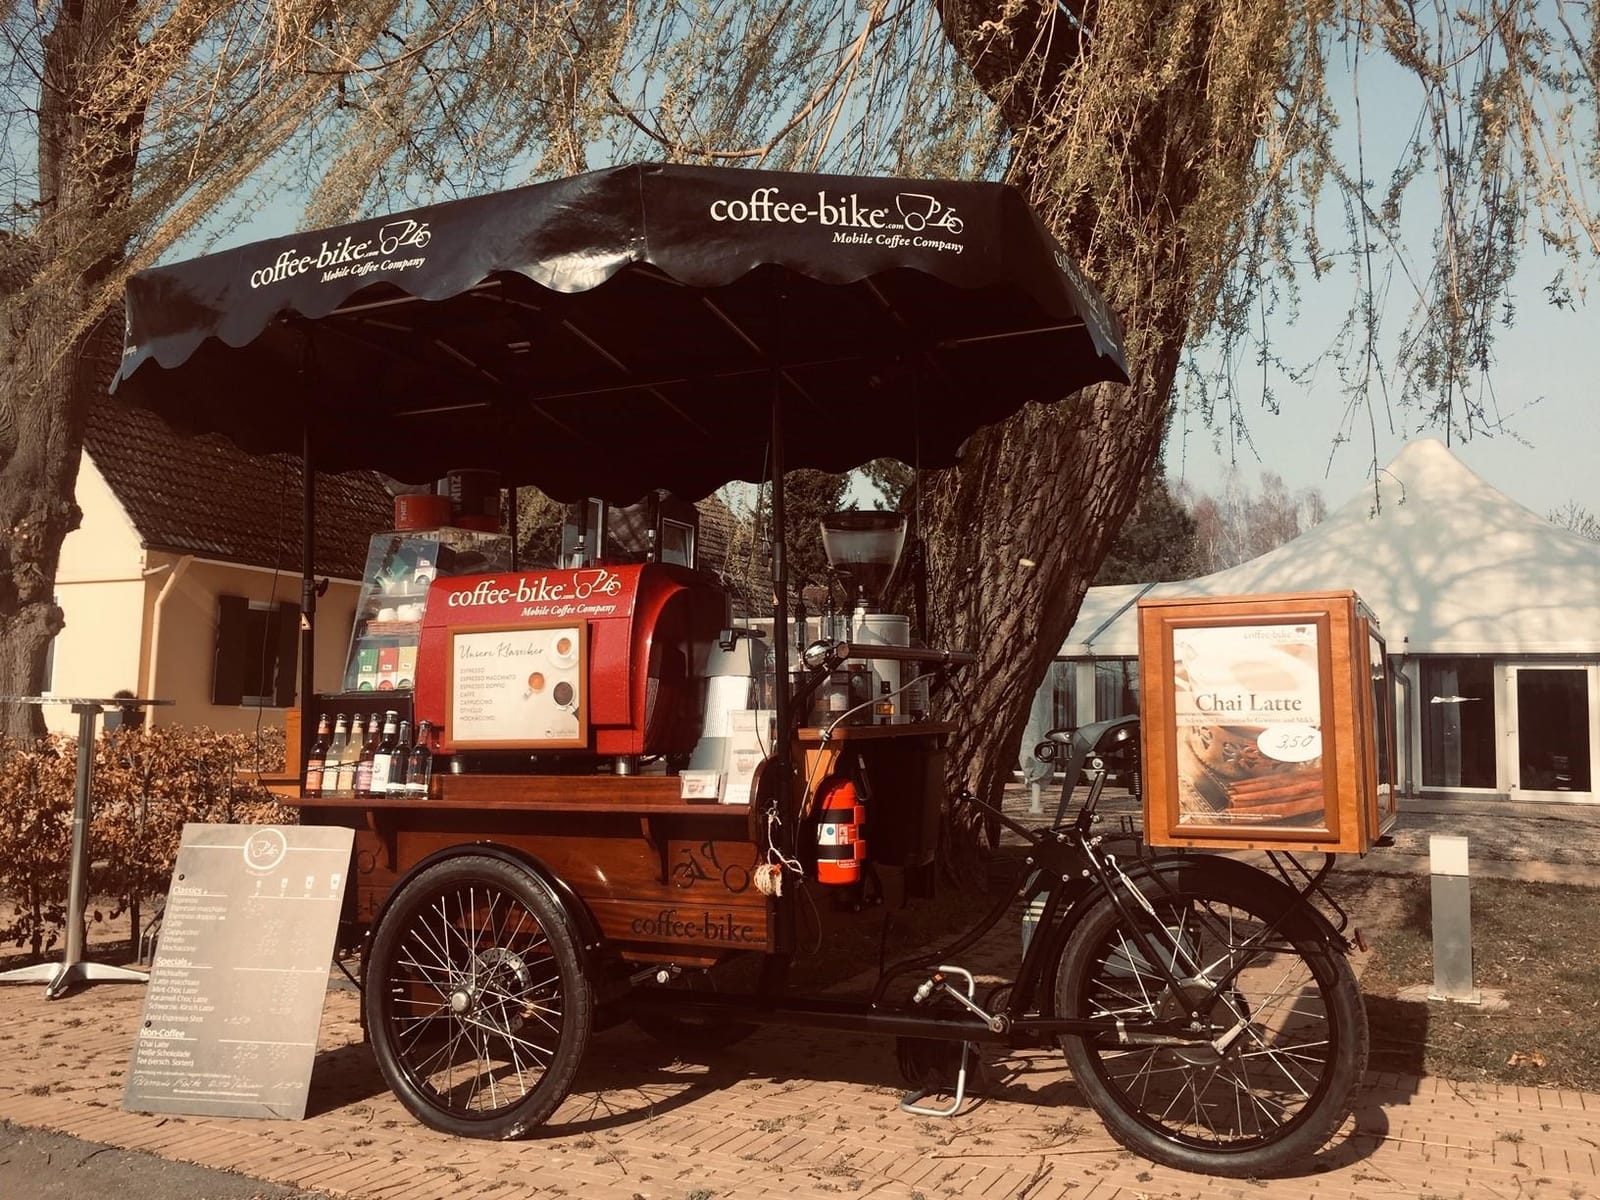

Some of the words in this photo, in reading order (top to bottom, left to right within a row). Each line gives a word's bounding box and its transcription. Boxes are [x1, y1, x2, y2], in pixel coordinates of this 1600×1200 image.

[709, 187, 887, 230] coffee-bike
[832, 232, 873, 246] Mobile
[875, 234, 910, 249] Coffee
[912, 236, 965, 254] Company
[250, 236, 368, 289] coffee-bike
[320, 263, 350, 284] Mobile
[350, 257, 381, 278] Coffee
[381, 254, 426, 272] Company
[448, 576, 563, 608] coffee-bike
[521, 606, 550, 617] Mobile
[550, 604, 576, 618] Coffee
[577, 603, 616, 616] Company
[1195, 693, 1243, 712] Chai
[1249, 693, 1302, 712] Latte
[1275, 734, 1315, 750] 3,50
[631, 909, 754, 943] coffee-bike
[139, 1028, 185, 1038] Non-Coffee
